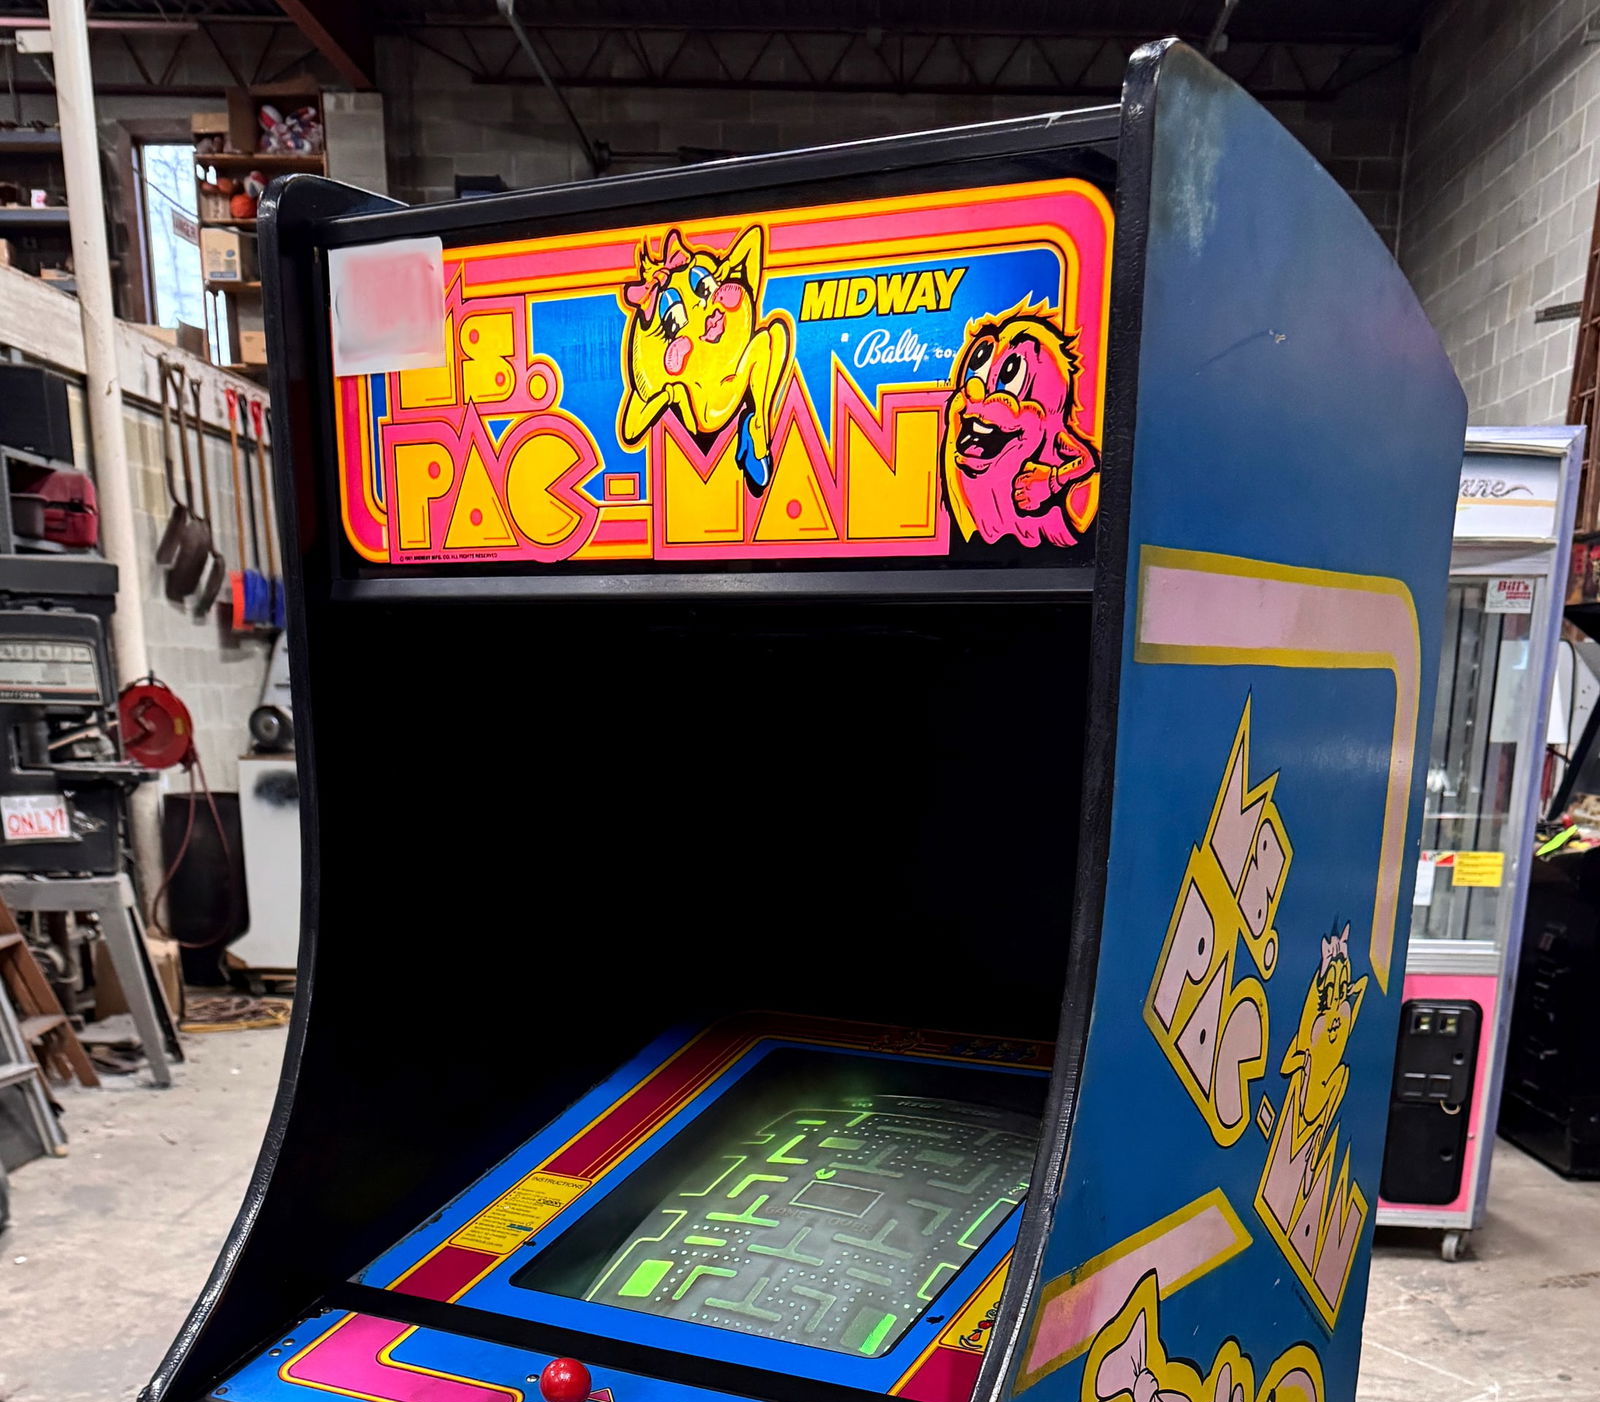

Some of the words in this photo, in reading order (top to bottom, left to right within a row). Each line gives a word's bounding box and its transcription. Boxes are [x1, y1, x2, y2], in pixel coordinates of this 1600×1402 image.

[799, 267, 969, 322] MIDWAY
[853, 328, 928, 373] Bally
[391, 398, 942, 553] PAC-MAN
[533, 1176, 584, 1190] INSTRUCTIONS
